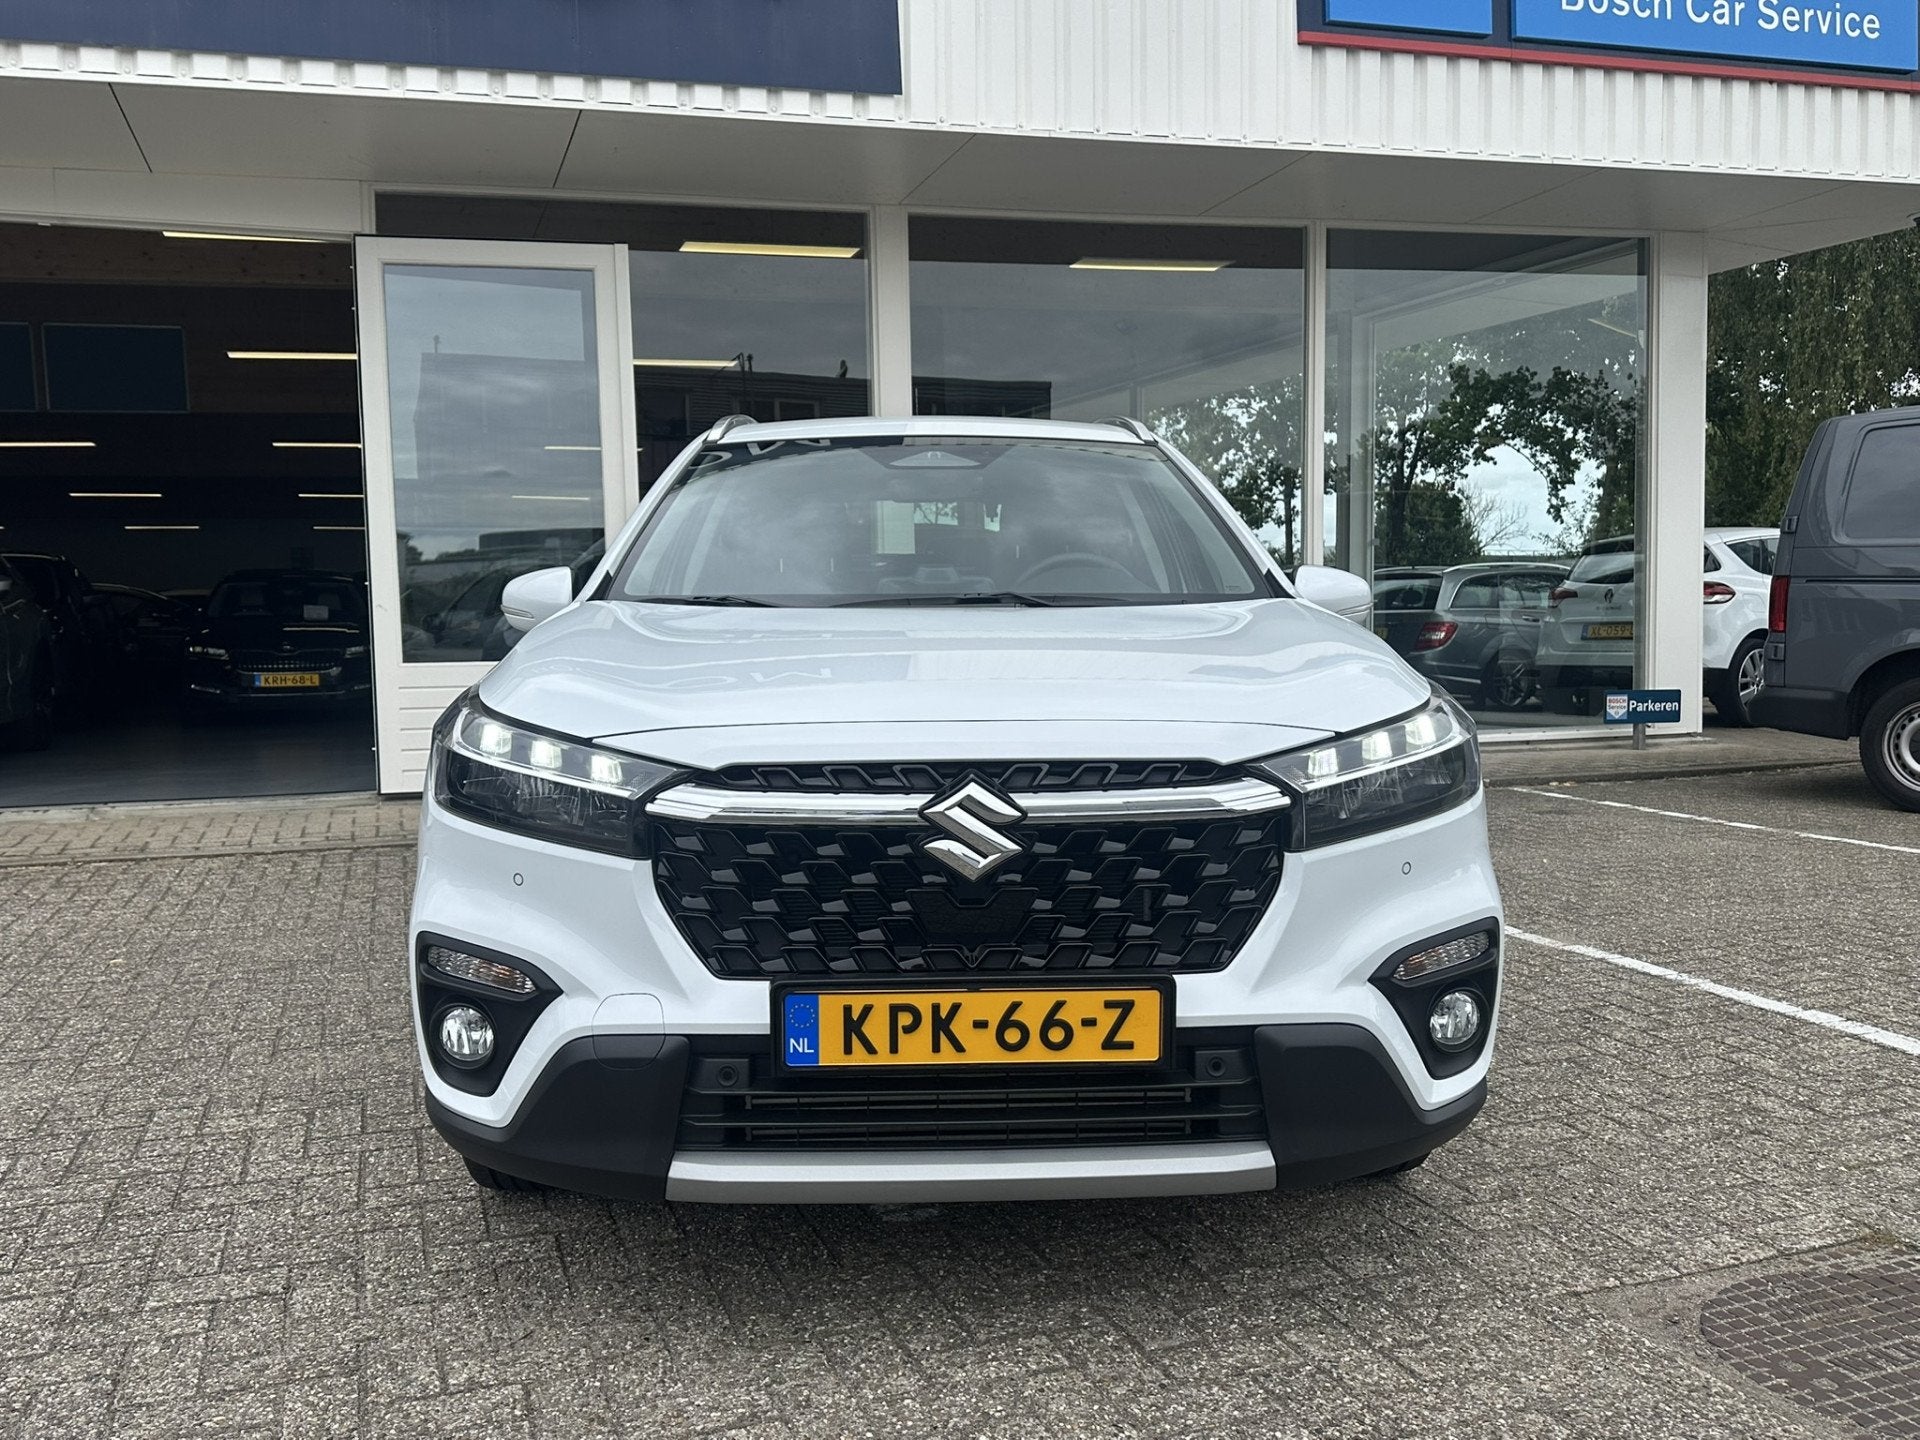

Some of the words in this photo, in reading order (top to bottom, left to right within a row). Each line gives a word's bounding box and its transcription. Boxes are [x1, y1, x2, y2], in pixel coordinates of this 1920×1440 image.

[1685, 0, 1746, 26] Car
[1757, 0, 1880, 39] Service
[264, 675, 316, 685] KRH-68-L
[1629, 700, 1679, 711] Parkeren
[842, 999, 1136, 1056] KPK-66-Z
[789, 1037, 815, 1054] NL
